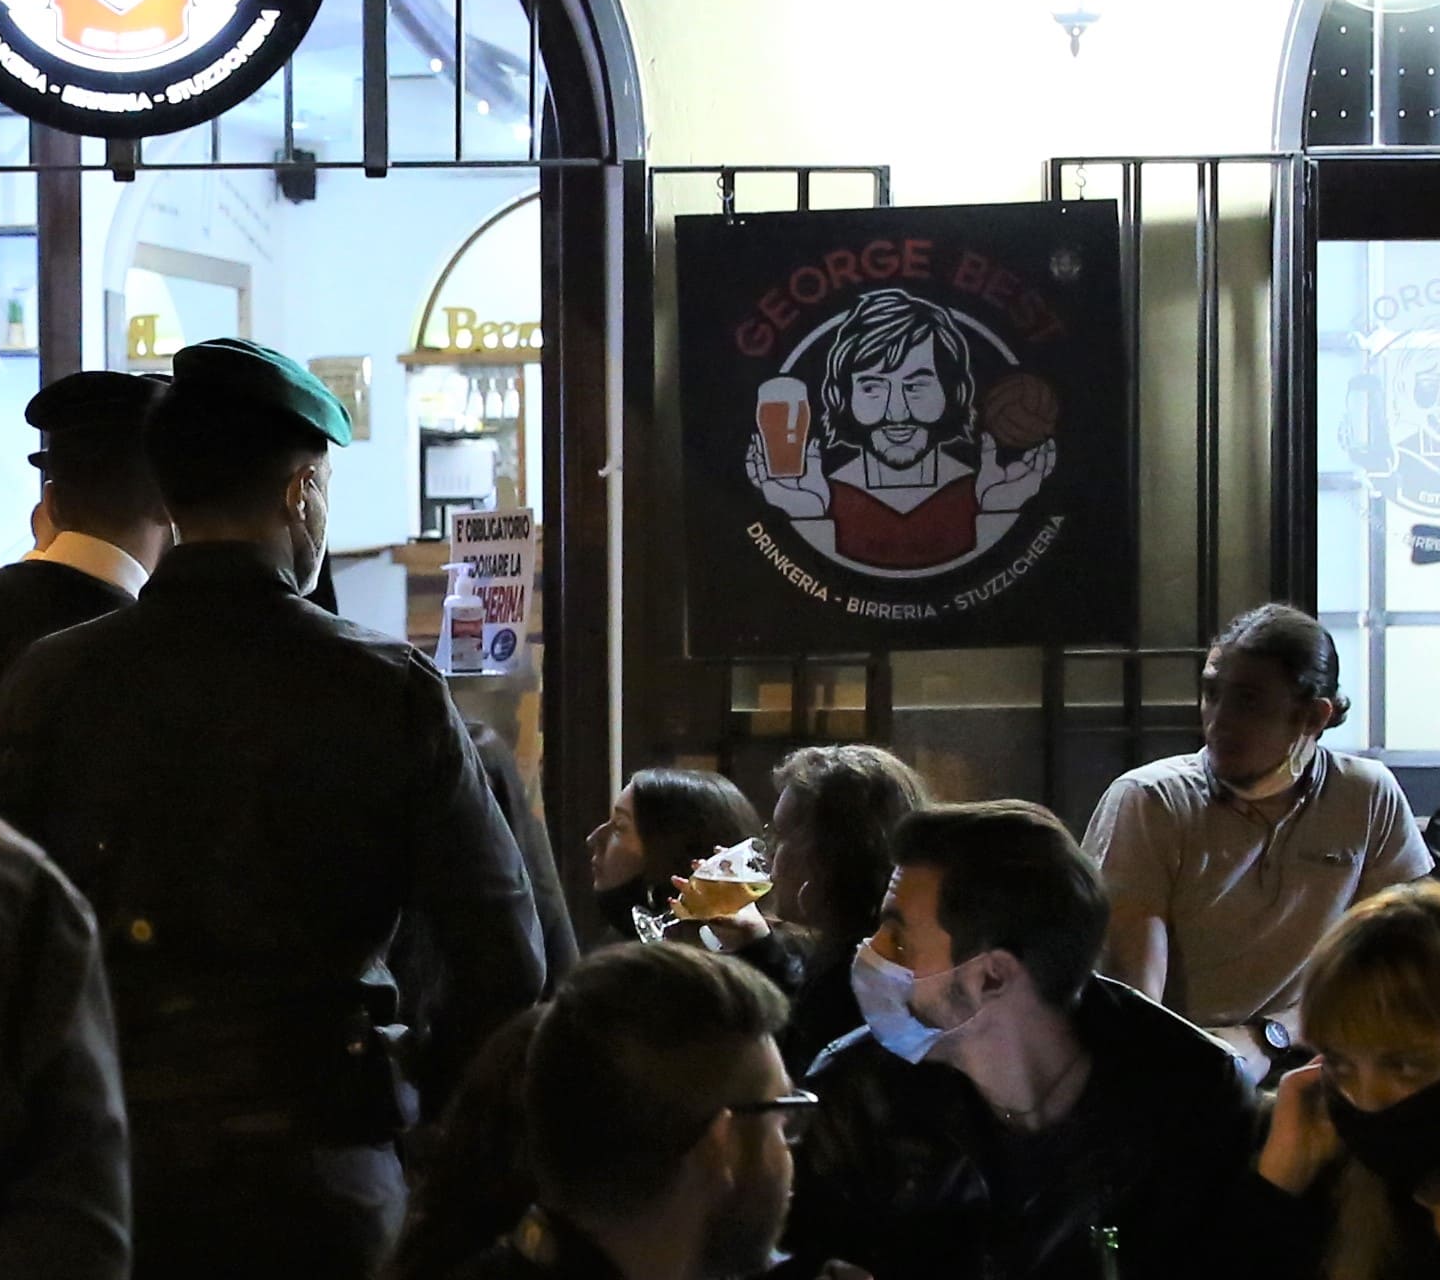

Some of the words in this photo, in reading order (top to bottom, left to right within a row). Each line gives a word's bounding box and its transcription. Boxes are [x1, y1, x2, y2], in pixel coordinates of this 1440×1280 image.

[735, 239, 936, 357] GEORGE
[953, 251, 1067, 344] BEST
[465, 515, 530, 543] OBBLIGATORIO
[511, 553, 522, 577] LA
[747, 522, 828, 603] DRINKERIA
[847, 596, 938, 620] BIRRERIA
[955, 513, 1066, 612] STUZZICHERIA
